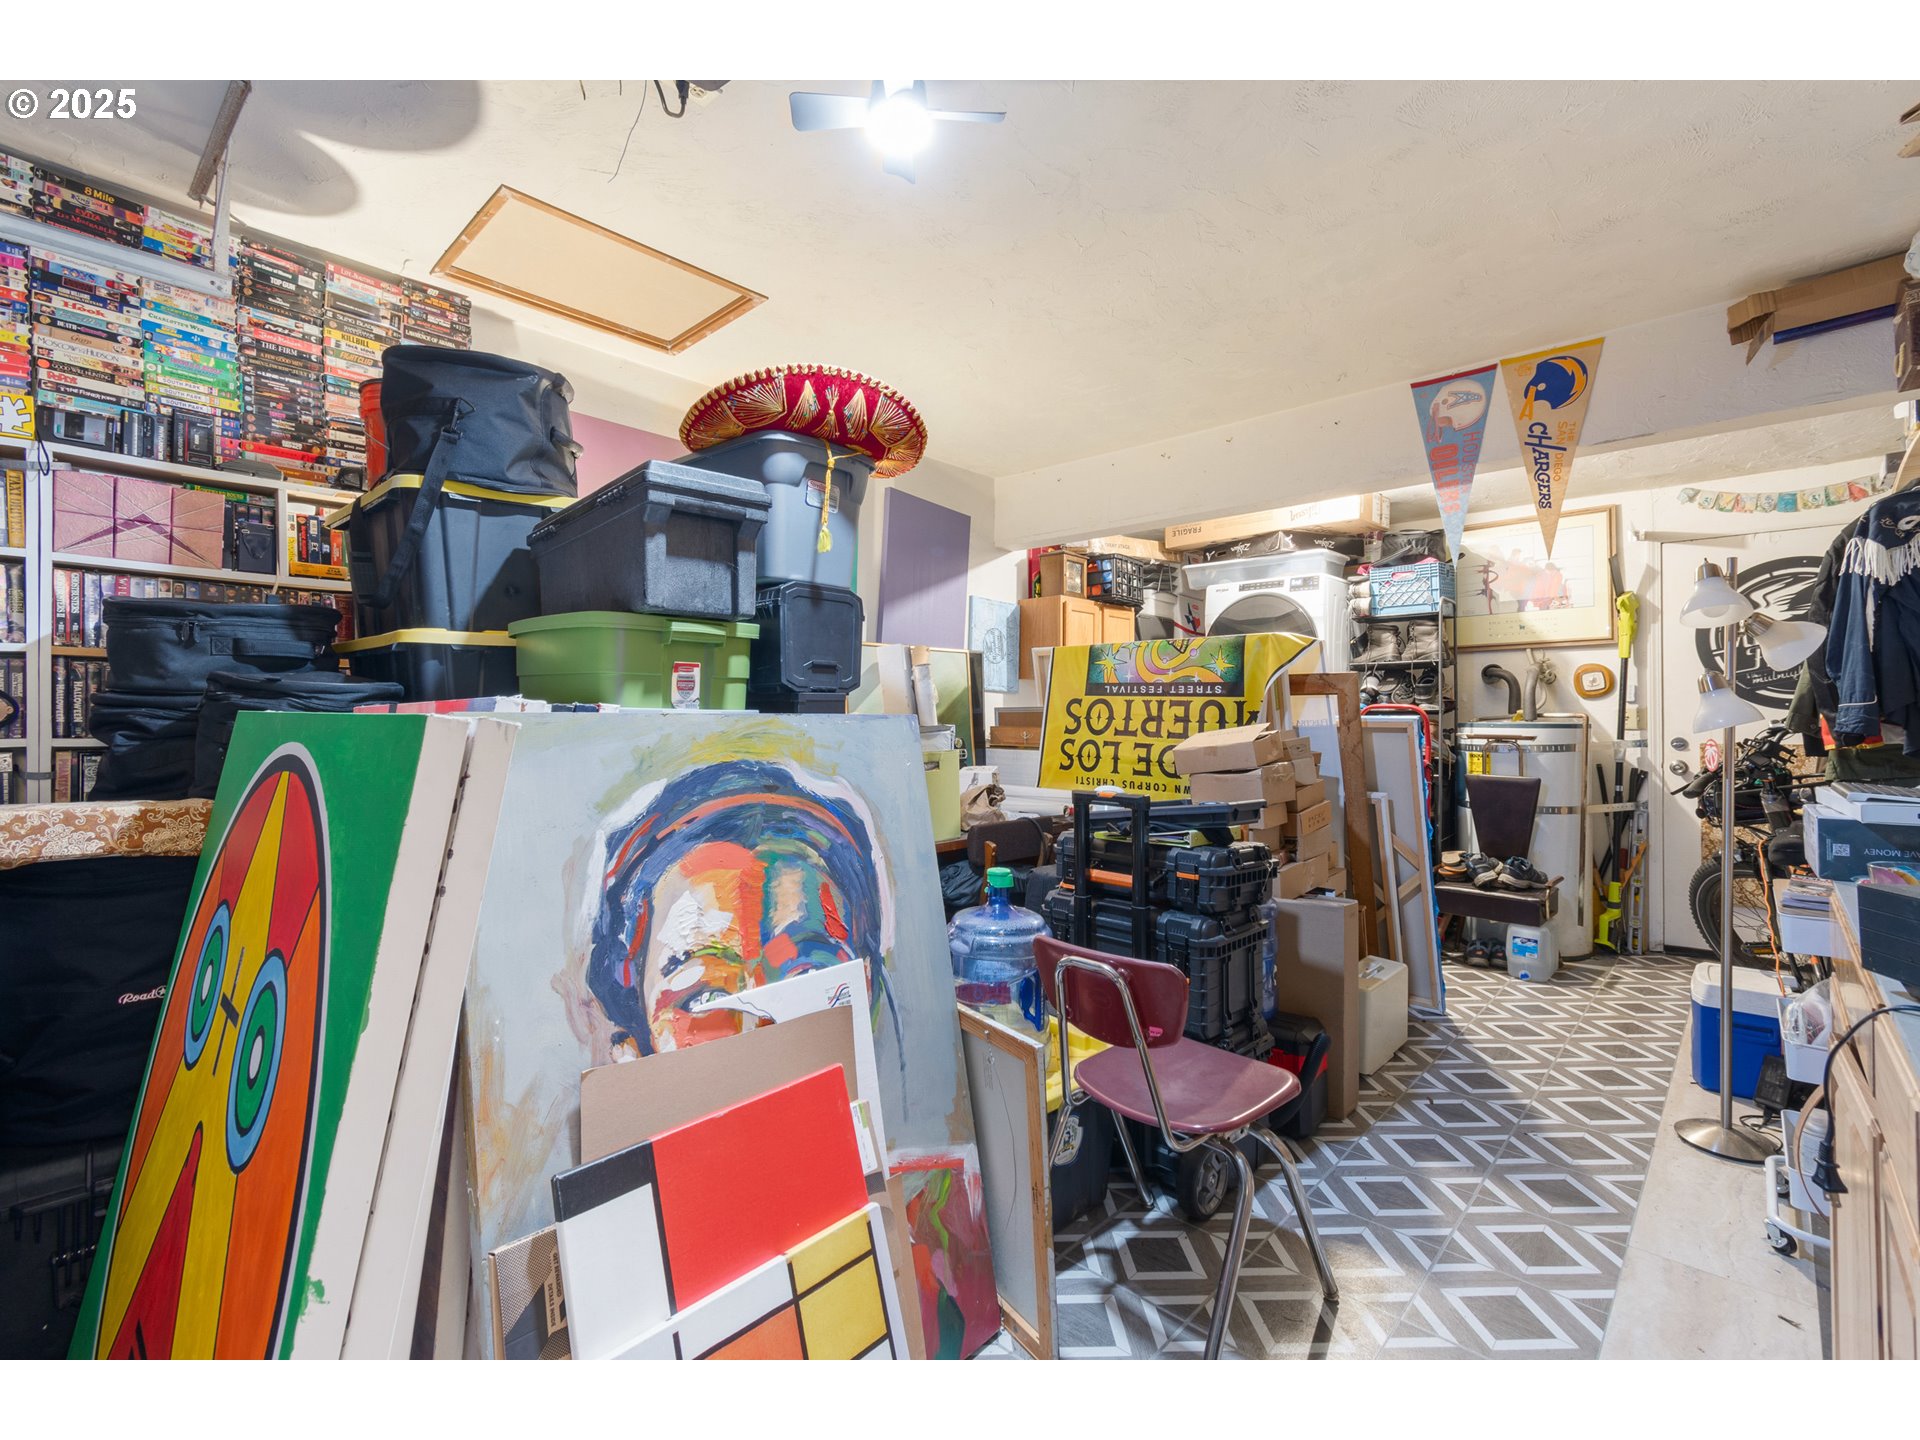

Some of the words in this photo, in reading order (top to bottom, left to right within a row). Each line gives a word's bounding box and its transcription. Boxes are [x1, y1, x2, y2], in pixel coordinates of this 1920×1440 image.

[84, 187, 92, 195] 8
[93, 188, 115, 205] Mile
[270, 276, 282, 286] TOP
[282, 280, 296, 291] GUN
[63, 301, 107, 319] Hook
[253, 301, 292, 316] COLLATERAL
[37, 336, 77, 352] MOSCOW
[86, 348, 119, 362] HUDSON
[261, 340, 278, 350] THE
[278, 346, 298, 356] FIRM
[357, 356, 374, 367] CLUB
[51, 363, 71, 371] GOOD
[85, 370, 111, 381] HUNTING
[163, 377, 184, 387] SOUTH
[184, 381, 201, 390] PARK
[164, 388, 185, 398] SOUTH
[186, 392, 202, 401] PARK
[165, 399, 187, 408] SOUTH
[187, 402, 204, 411] PARK
[1556, 421, 1568, 445] SAN
[1567, 421, 1577, 441] THE
[1524, 421, 1567, 510] CHARGERS
[1552, 452, 1565, 482] DIEGO
[8, 475, 23, 496] TAXI
[9, 498, 23, 534] DRIVER
[1171, 526, 1202, 538] FRAGILE
[1104, 685, 1163, 694] FESTIVAL
[1169, 685, 1222, 695] STREET
[56, 683, 65, 723] HALLOWEEN
[73, 681, 84, 723] HALLOWEEN
[1058, 738, 1123, 775] LOS
[1132, 741, 1182, 780] DE
[1075, 776, 1115, 788] CHRISTI
[1122, 780, 1167, 792] CORPUS
[1863, 848, 1901, 858] MONEY
[547, 1282, 555, 1307] DETAILS
[549, 1307, 557, 1328] INSIDE
